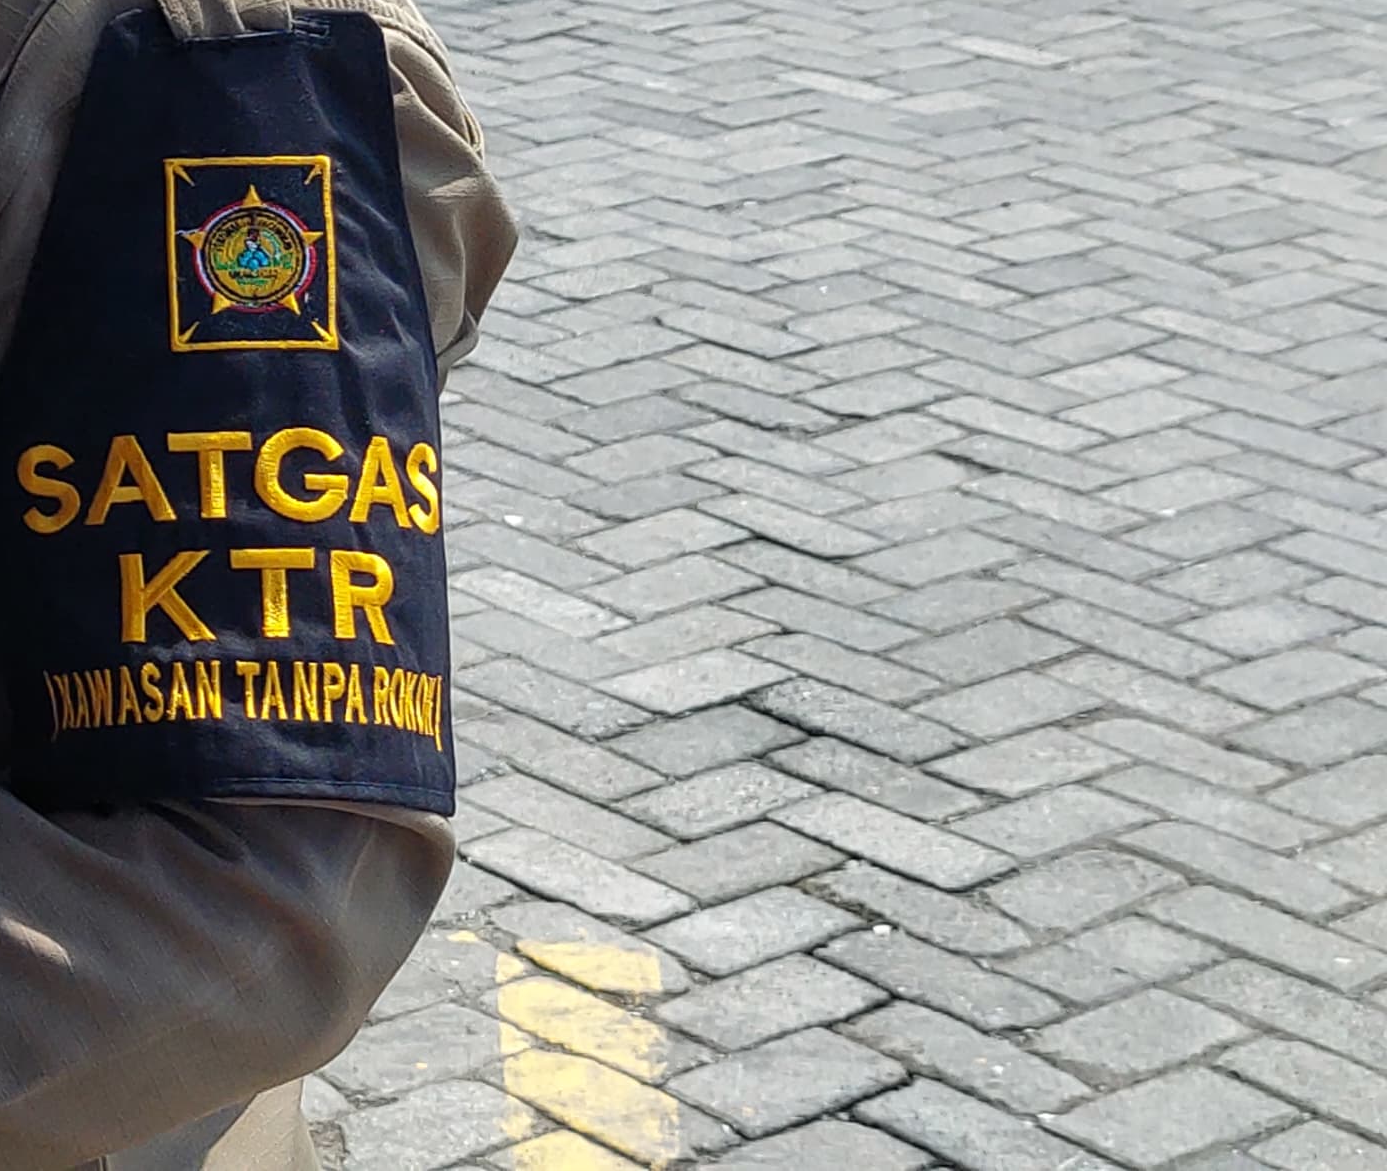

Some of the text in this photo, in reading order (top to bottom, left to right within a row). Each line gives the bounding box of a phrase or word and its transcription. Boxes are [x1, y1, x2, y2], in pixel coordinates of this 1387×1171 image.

[16, 426, 440, 535] SATGAS
[118, 547, 396, 645] KTR
[235, 660, 368, 725] TANPA
